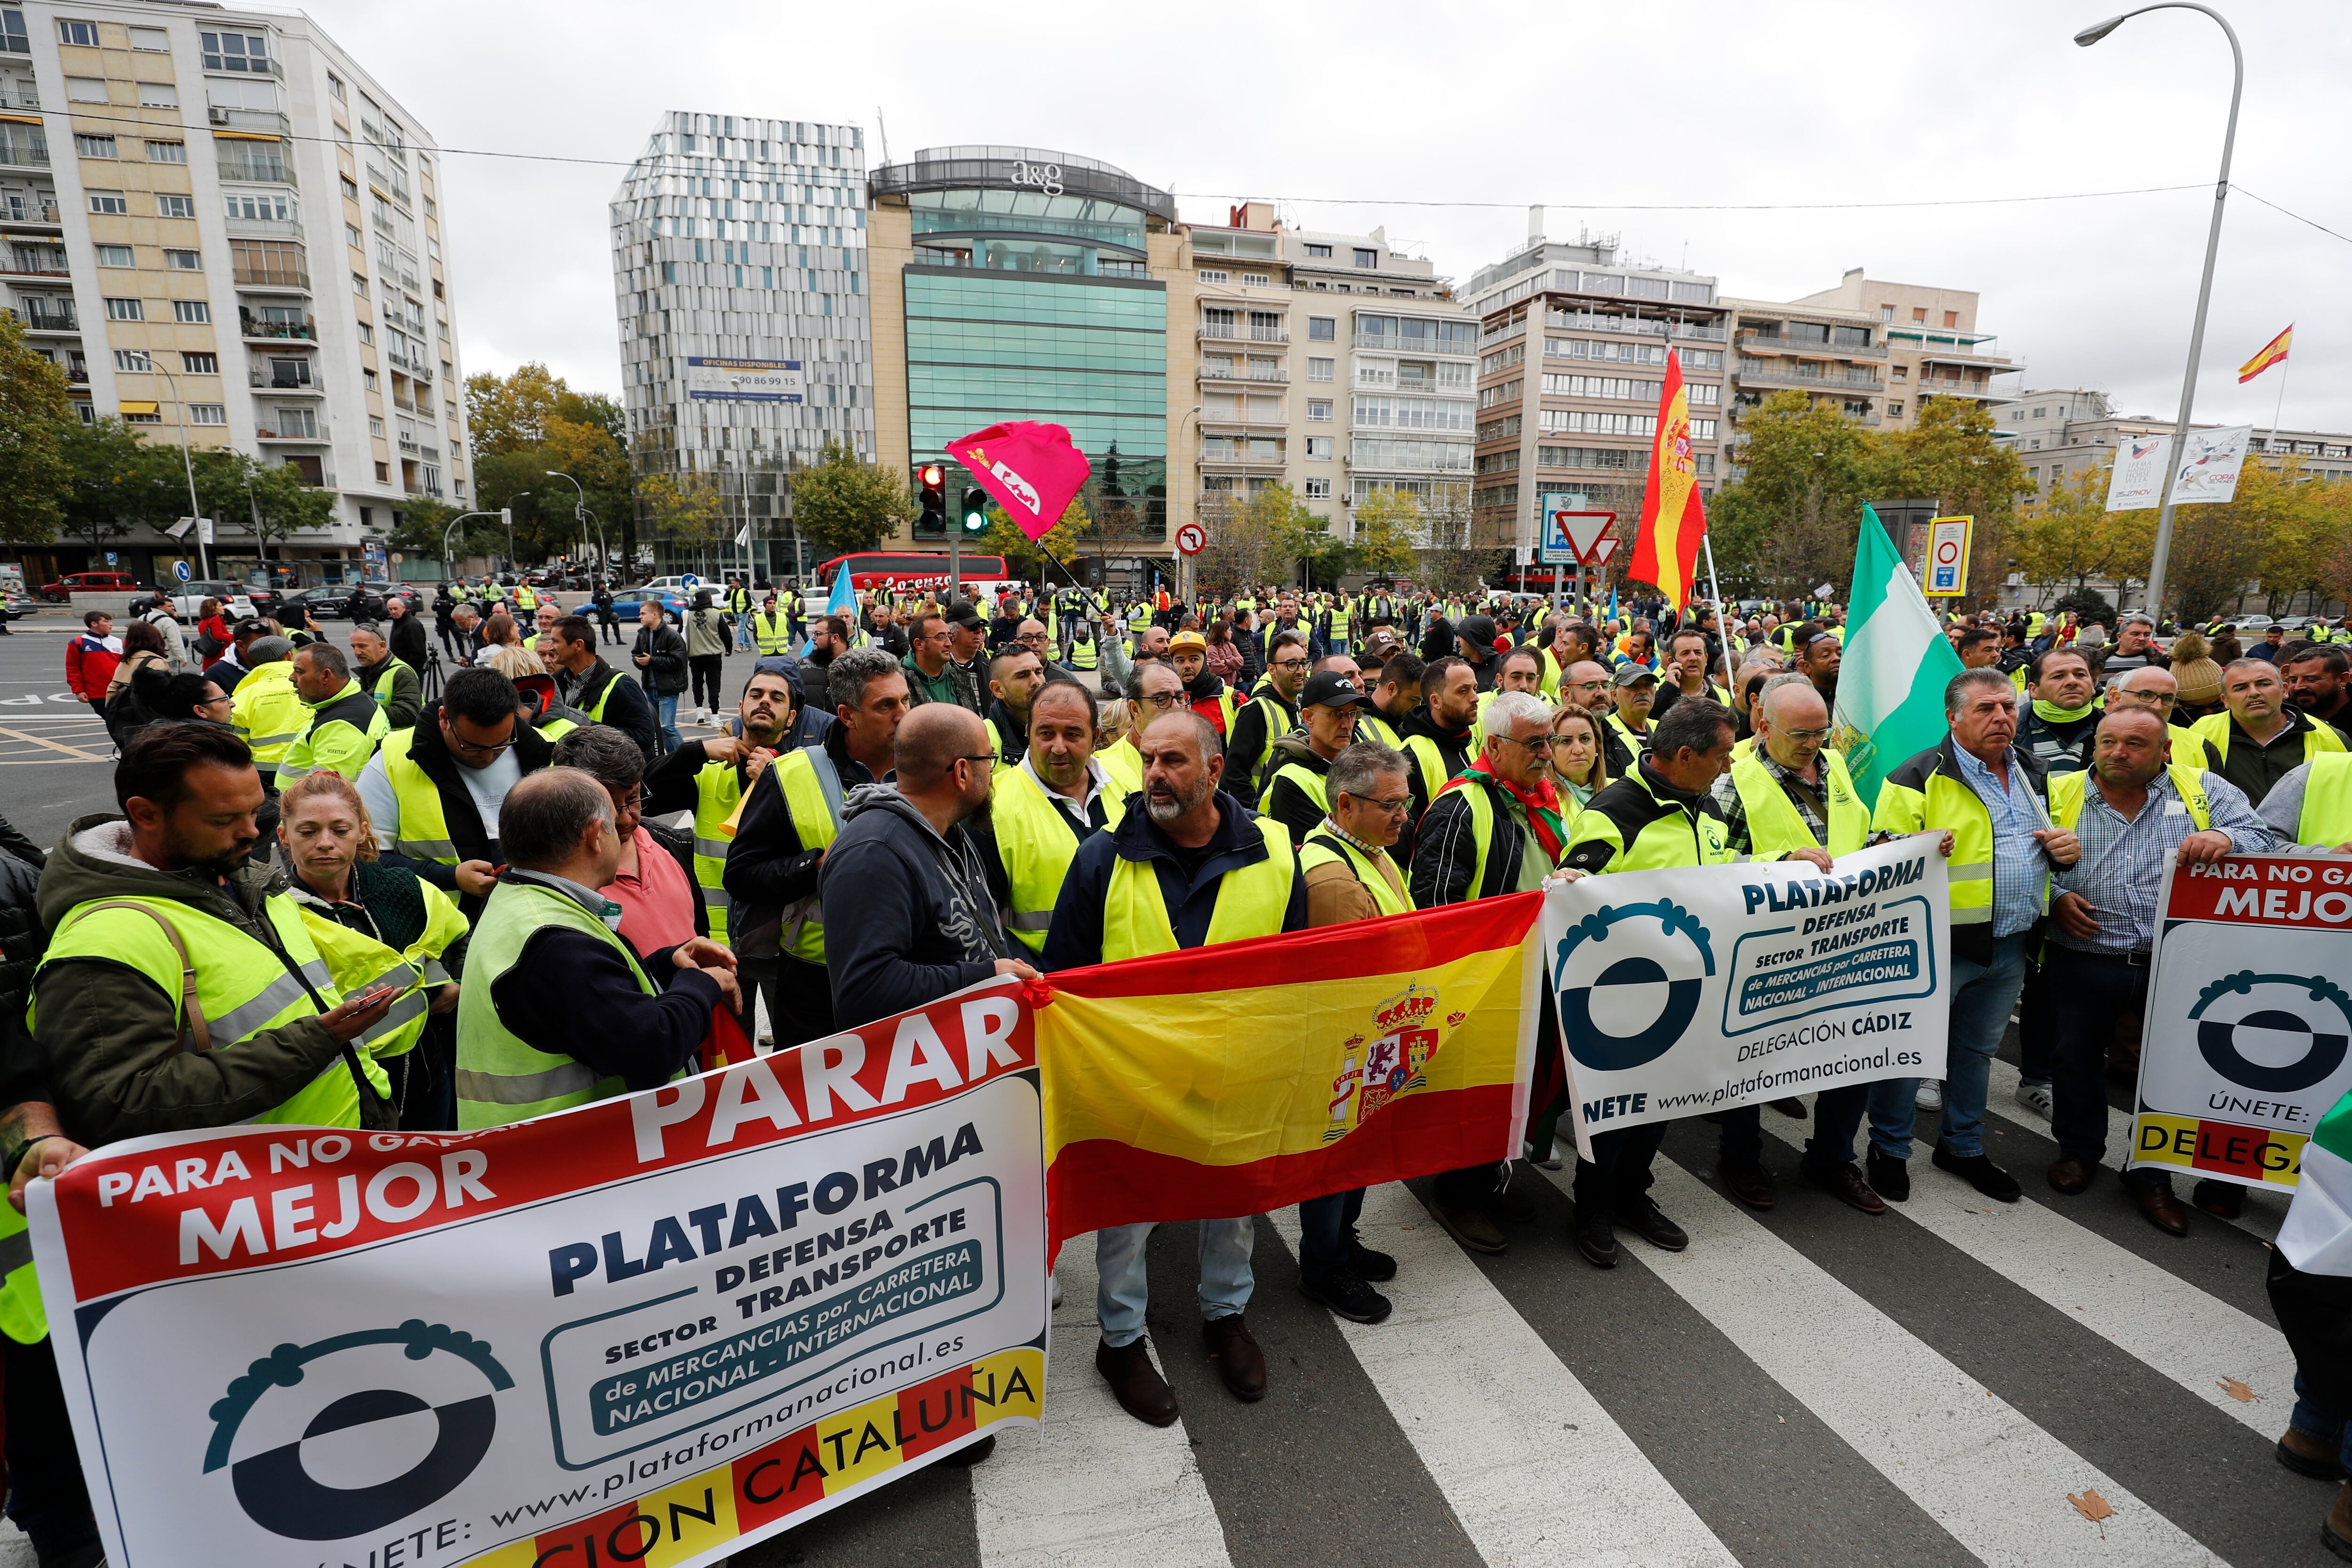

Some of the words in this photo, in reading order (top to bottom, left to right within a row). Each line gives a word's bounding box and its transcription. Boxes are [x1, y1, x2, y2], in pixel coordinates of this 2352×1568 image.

[1011, 161, 1064, 196] a&g
[739, 360, 786, 369] DISPONIBLES
[1741, 856, 1925, 915] PLATAFORMA
[2190, 862, 2259, 881] PARA
[2267, 865, 2313, 883] NO
[1755, 947, 1804, 969] SECTOR
[1810, 916, 1910, 956] TRANSPORTE
[1802, 902, 1876, 936] DEFENSA
[1743, 986, 1807, 1012] NACIONAL
[1815, 963, 1911, 995] INTERNACIONAL
[1748, 978, 1764, 992] de
[1765, 962, 1834, 989] MERCANCIAS
[1834, 959, 1851, 975] por
[1851, 944, 1911, 965] CARRETERA
[1737, 1019, 1846, 1063] DELEGACIÓN
[1851, 1011, 1913, 1036] CÁDIZ
[631, 995, 1021, 1164] PARAR
[1657, 1048, 1923, 1111] www.plataformanacional.es
[2208, 1090, 2310, 1123] ÚNETE:
[98, 1151, 250, 1208] PARA
[270, 1134, 351, 1174] NO
[2140, 1124, 2302, 1175] DELEG
[179, 1149, 497, 1266] MEJOR
[548, 1122, 984, 1297] PLATAFORMA
[715, 1209, 894, 1294] DEFENSA
[604, 1316, 717, 1365] SECTOR
[735, 1208, 967, 1320] TRANSPORTE
[604, 1379, 637, 1402] de
[645, 1313, 810, 1386] MERCANCIAS
[816, 1300, 852, 1327] por
[857, 1247, 972, 1305] CARRETERA
[609, 1362, 760, 1429] NACIONAL
[785, 1271, 974, 1364] INTERNACIONAL
[490, 1334, 965, 1528] www.plataformanacional.es
[742, 1365, 1037, 1505] CATALUÑA
